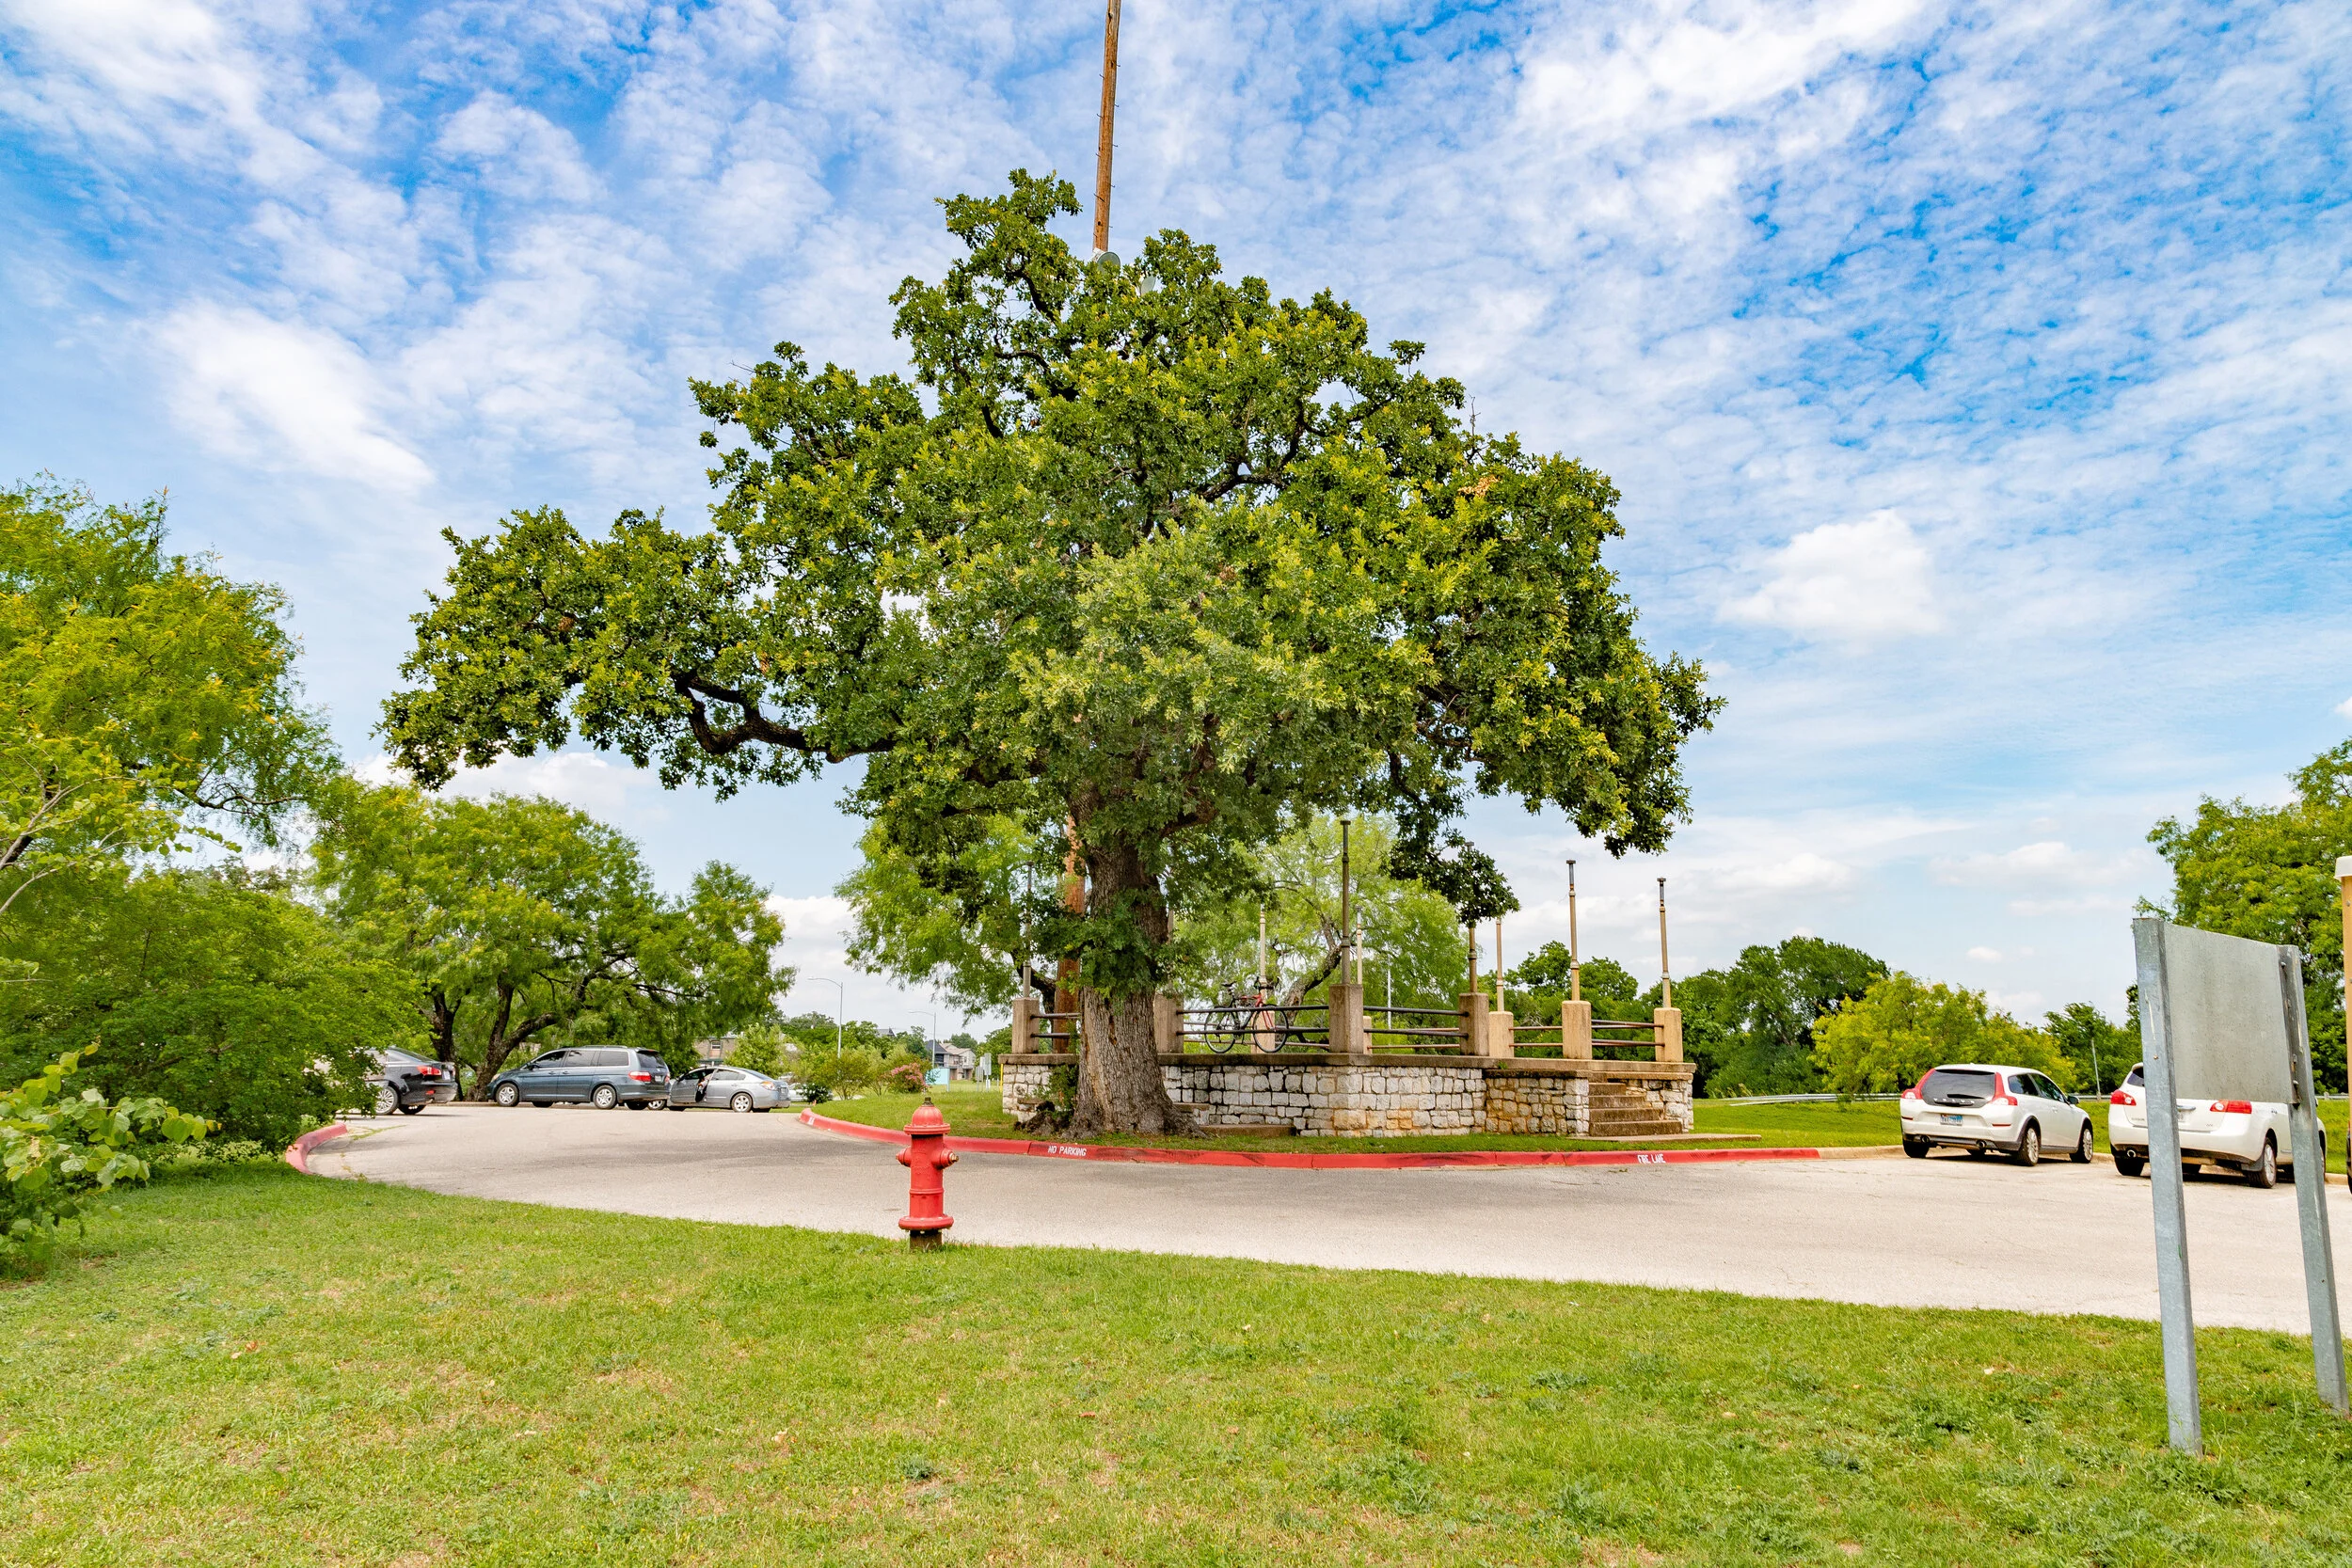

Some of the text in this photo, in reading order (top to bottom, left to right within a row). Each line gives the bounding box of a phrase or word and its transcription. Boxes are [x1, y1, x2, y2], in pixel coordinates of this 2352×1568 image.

[1047, 1146, 1087, 1156] NO PARKING
[1638, 1153, 1666, 1164] FIRE LANE
